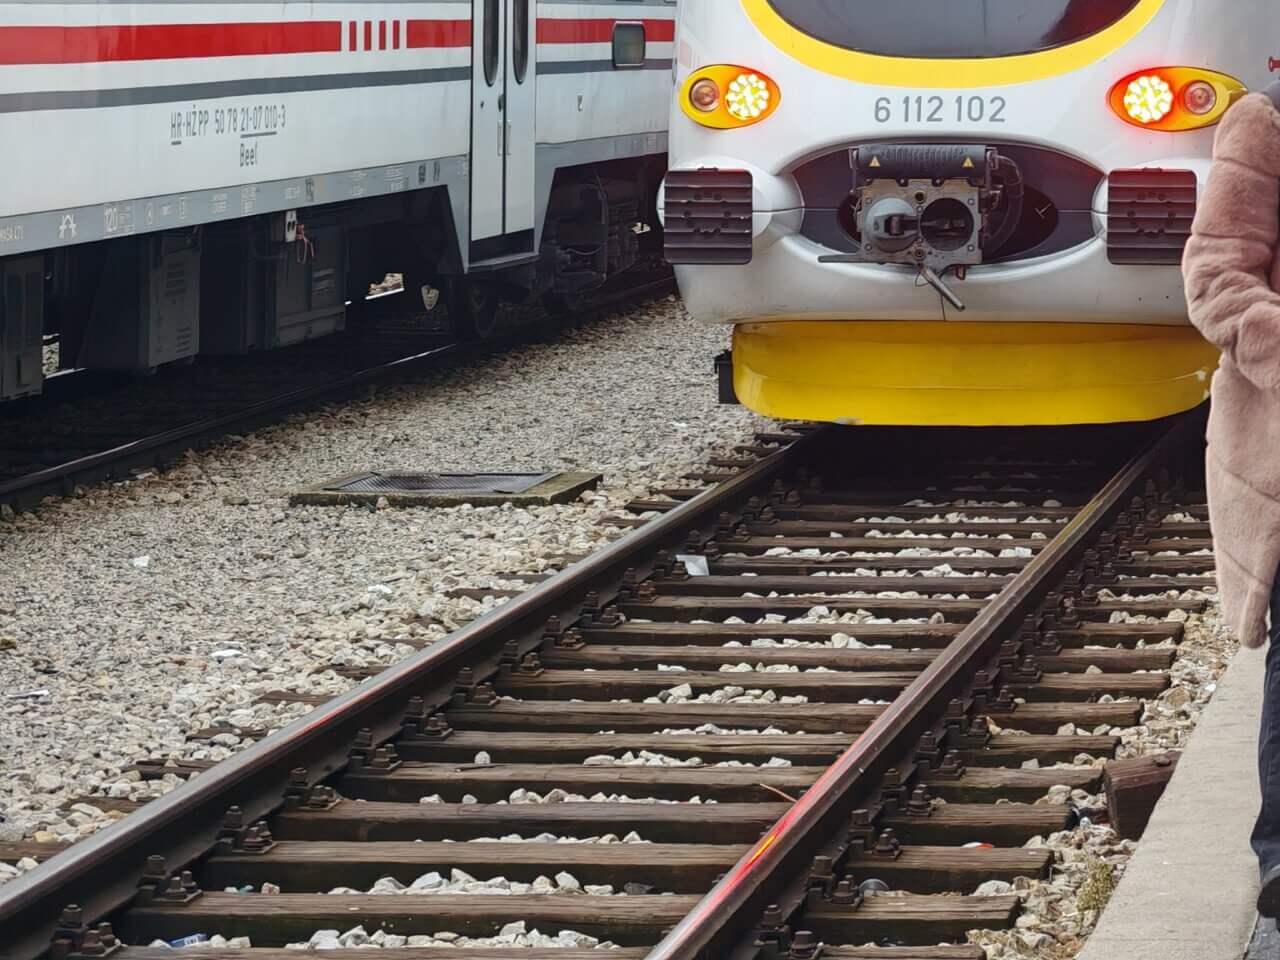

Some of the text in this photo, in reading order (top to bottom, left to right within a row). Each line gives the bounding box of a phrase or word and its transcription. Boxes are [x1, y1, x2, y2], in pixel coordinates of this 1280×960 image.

[215, 108, 225, 135] 50
[228, 107, 238, 133] 78
[874, 95, 1006, 123] 6 112 102
